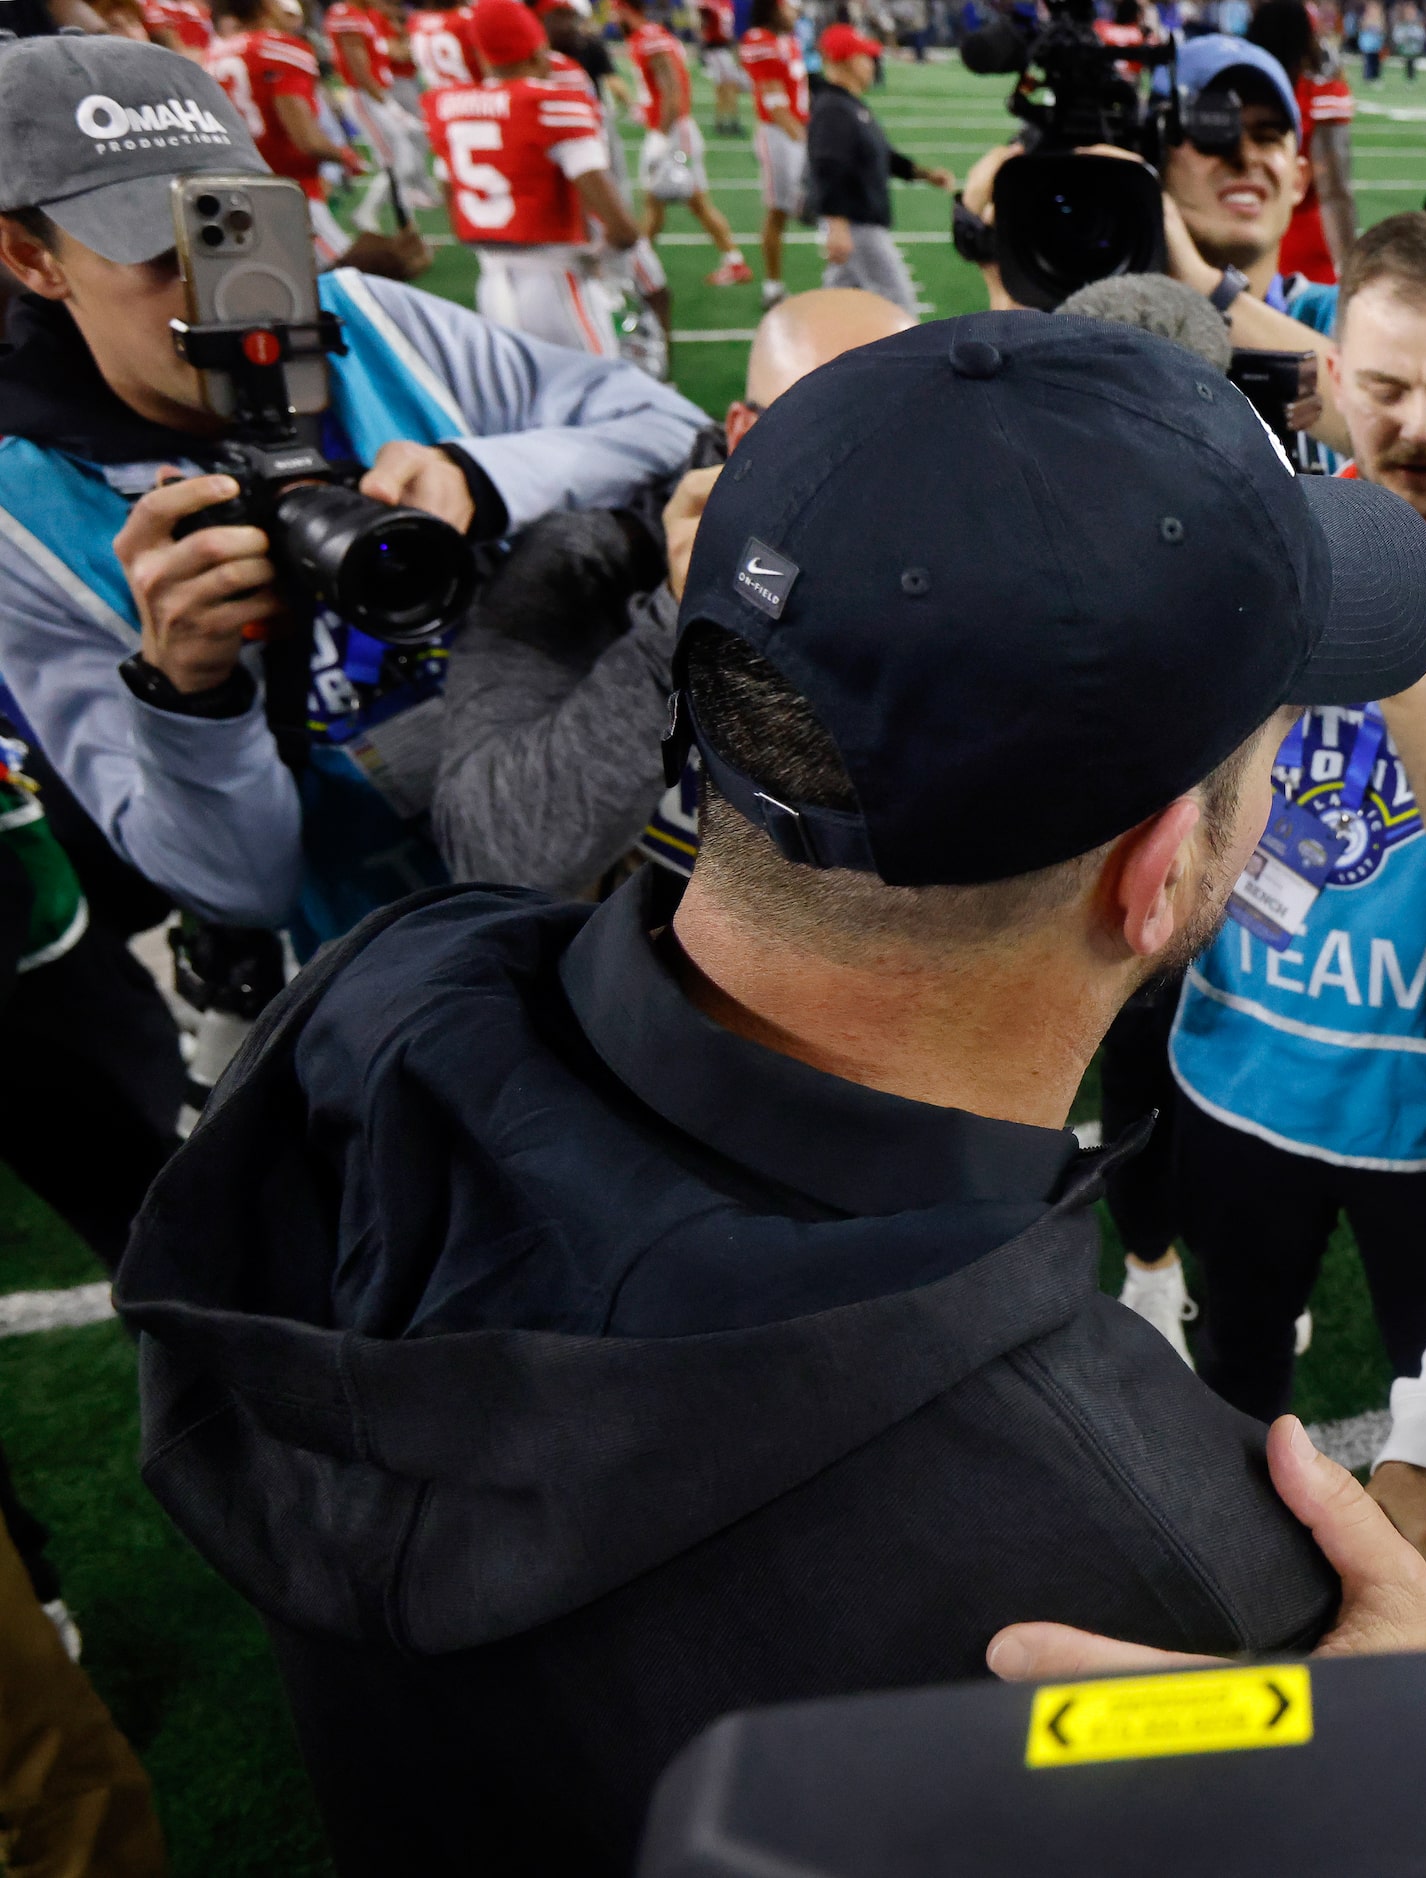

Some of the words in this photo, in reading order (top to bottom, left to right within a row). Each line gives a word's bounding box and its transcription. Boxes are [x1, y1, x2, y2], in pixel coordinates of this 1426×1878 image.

[76, 94, 229, 140] OMAHA
[94, 133, 232, 155] PRODUCTIONS
[445, 119, 516, 229] 5
[738, 572, 780, 604] ON-FIELD
